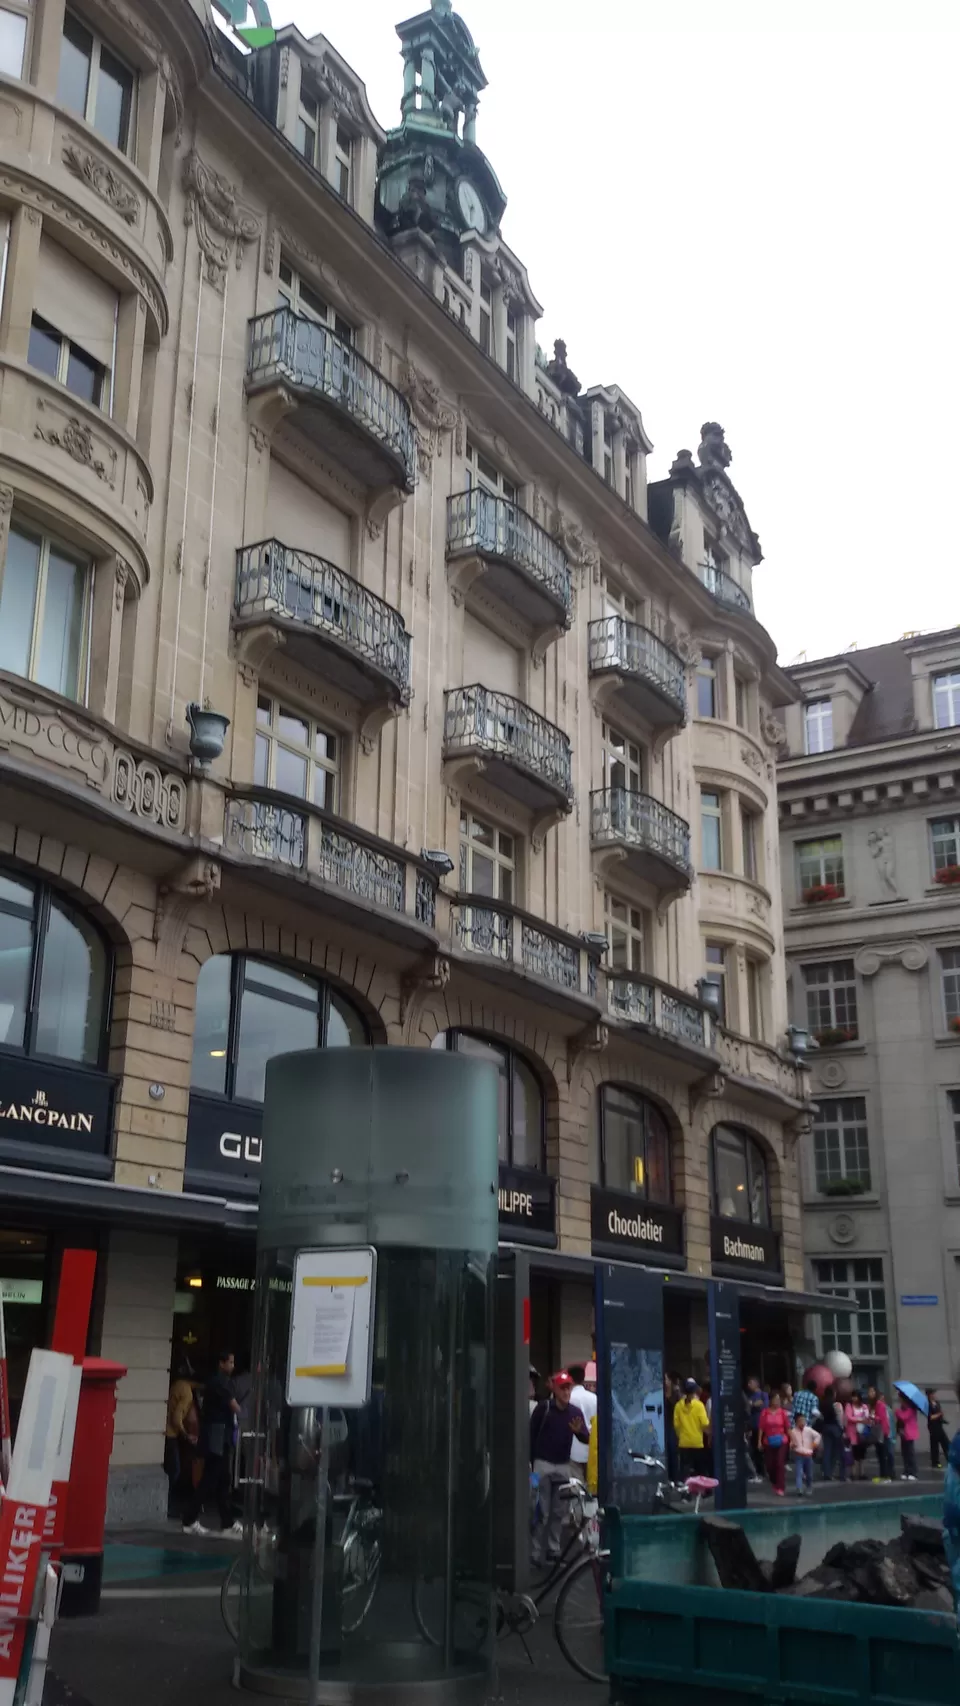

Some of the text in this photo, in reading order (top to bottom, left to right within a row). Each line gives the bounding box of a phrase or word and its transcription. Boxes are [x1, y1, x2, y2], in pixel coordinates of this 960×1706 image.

[608, 1209, 663, 1242] Chocolatier
[723, 1235, 765, 1262] Bachmann
[216, 1276, 249, 1290] PASSAGE
